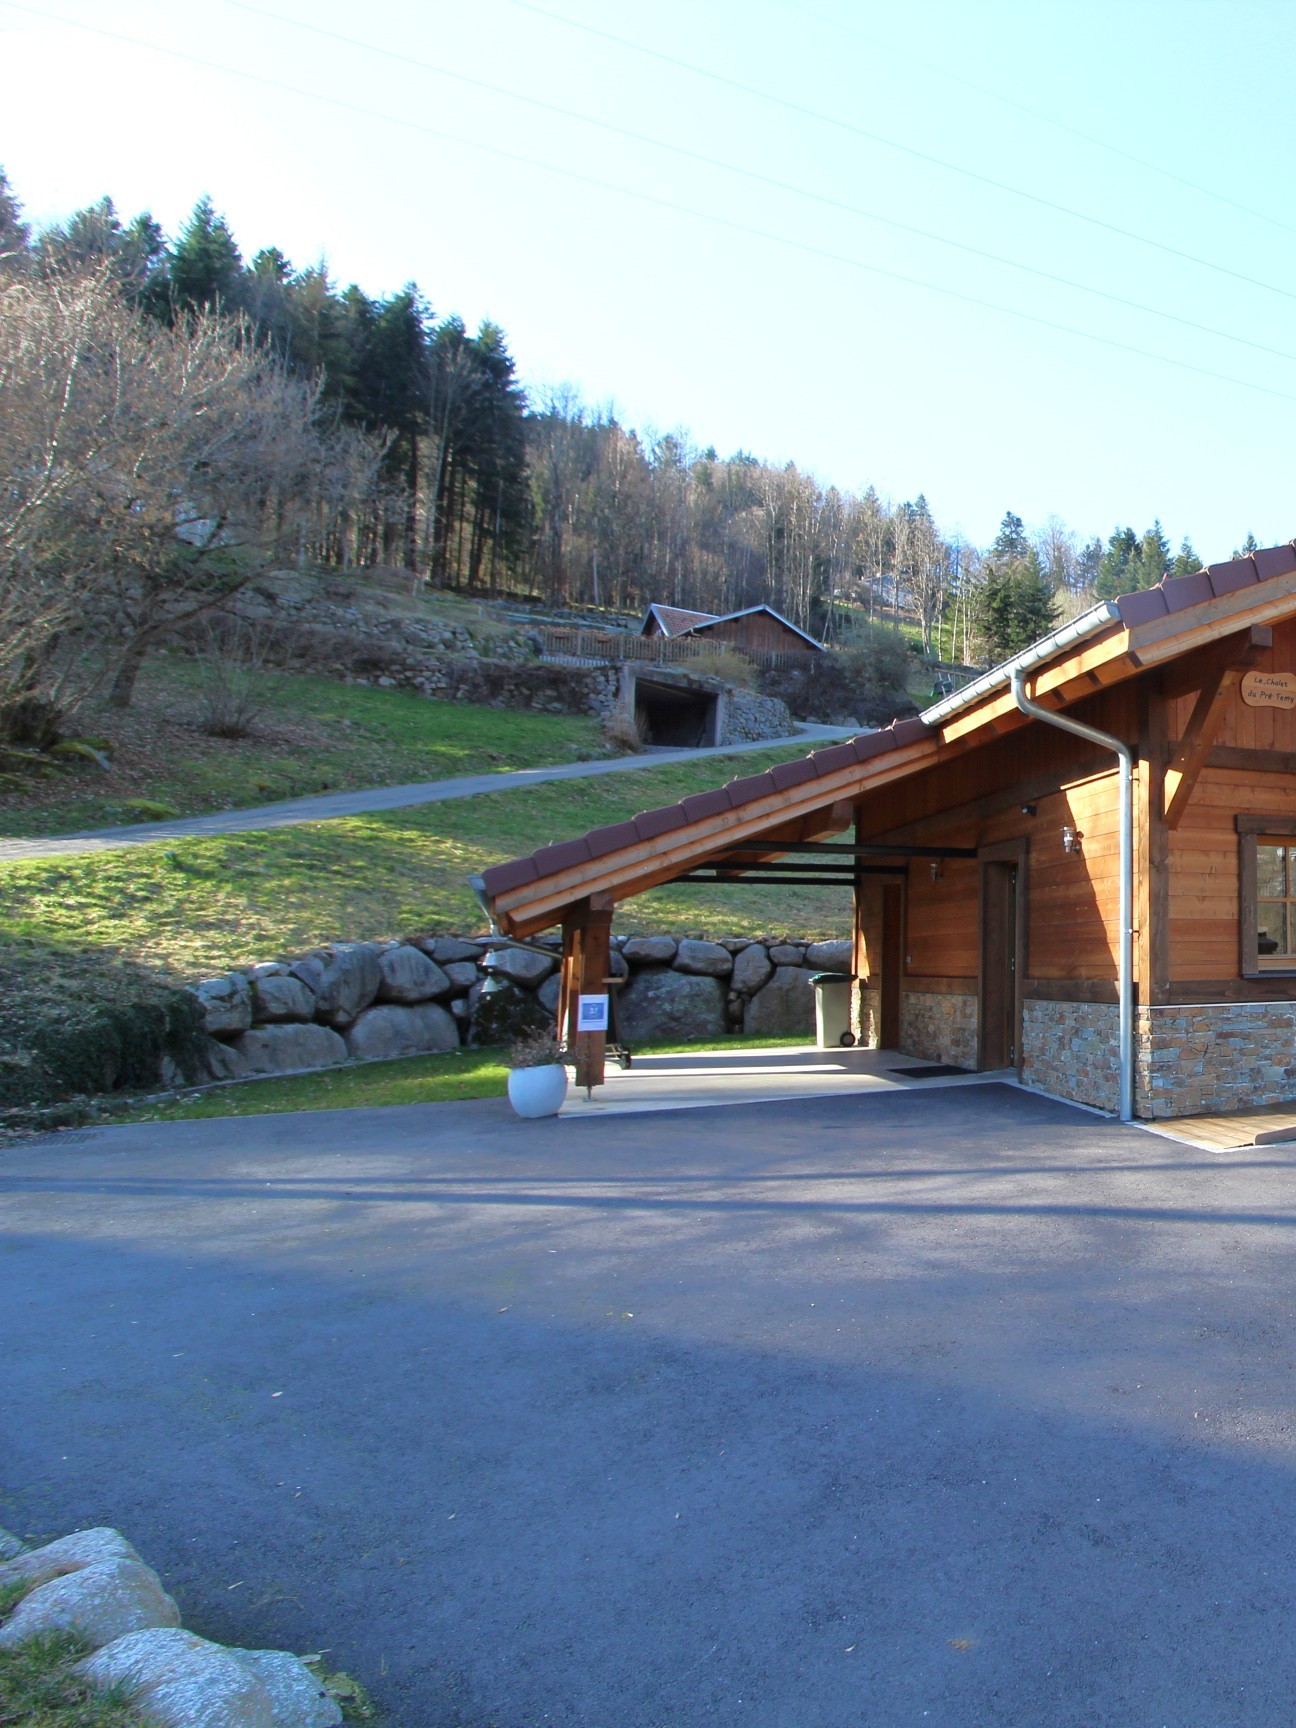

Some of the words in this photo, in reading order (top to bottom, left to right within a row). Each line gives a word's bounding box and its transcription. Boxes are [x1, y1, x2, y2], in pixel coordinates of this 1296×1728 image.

[1254, 676, 1263, 684] Le
[1266, 678, 1289, 688] Chalet
[1247, 689, 1257, 698] du
[1259, 690, 1273, 700] Pré
